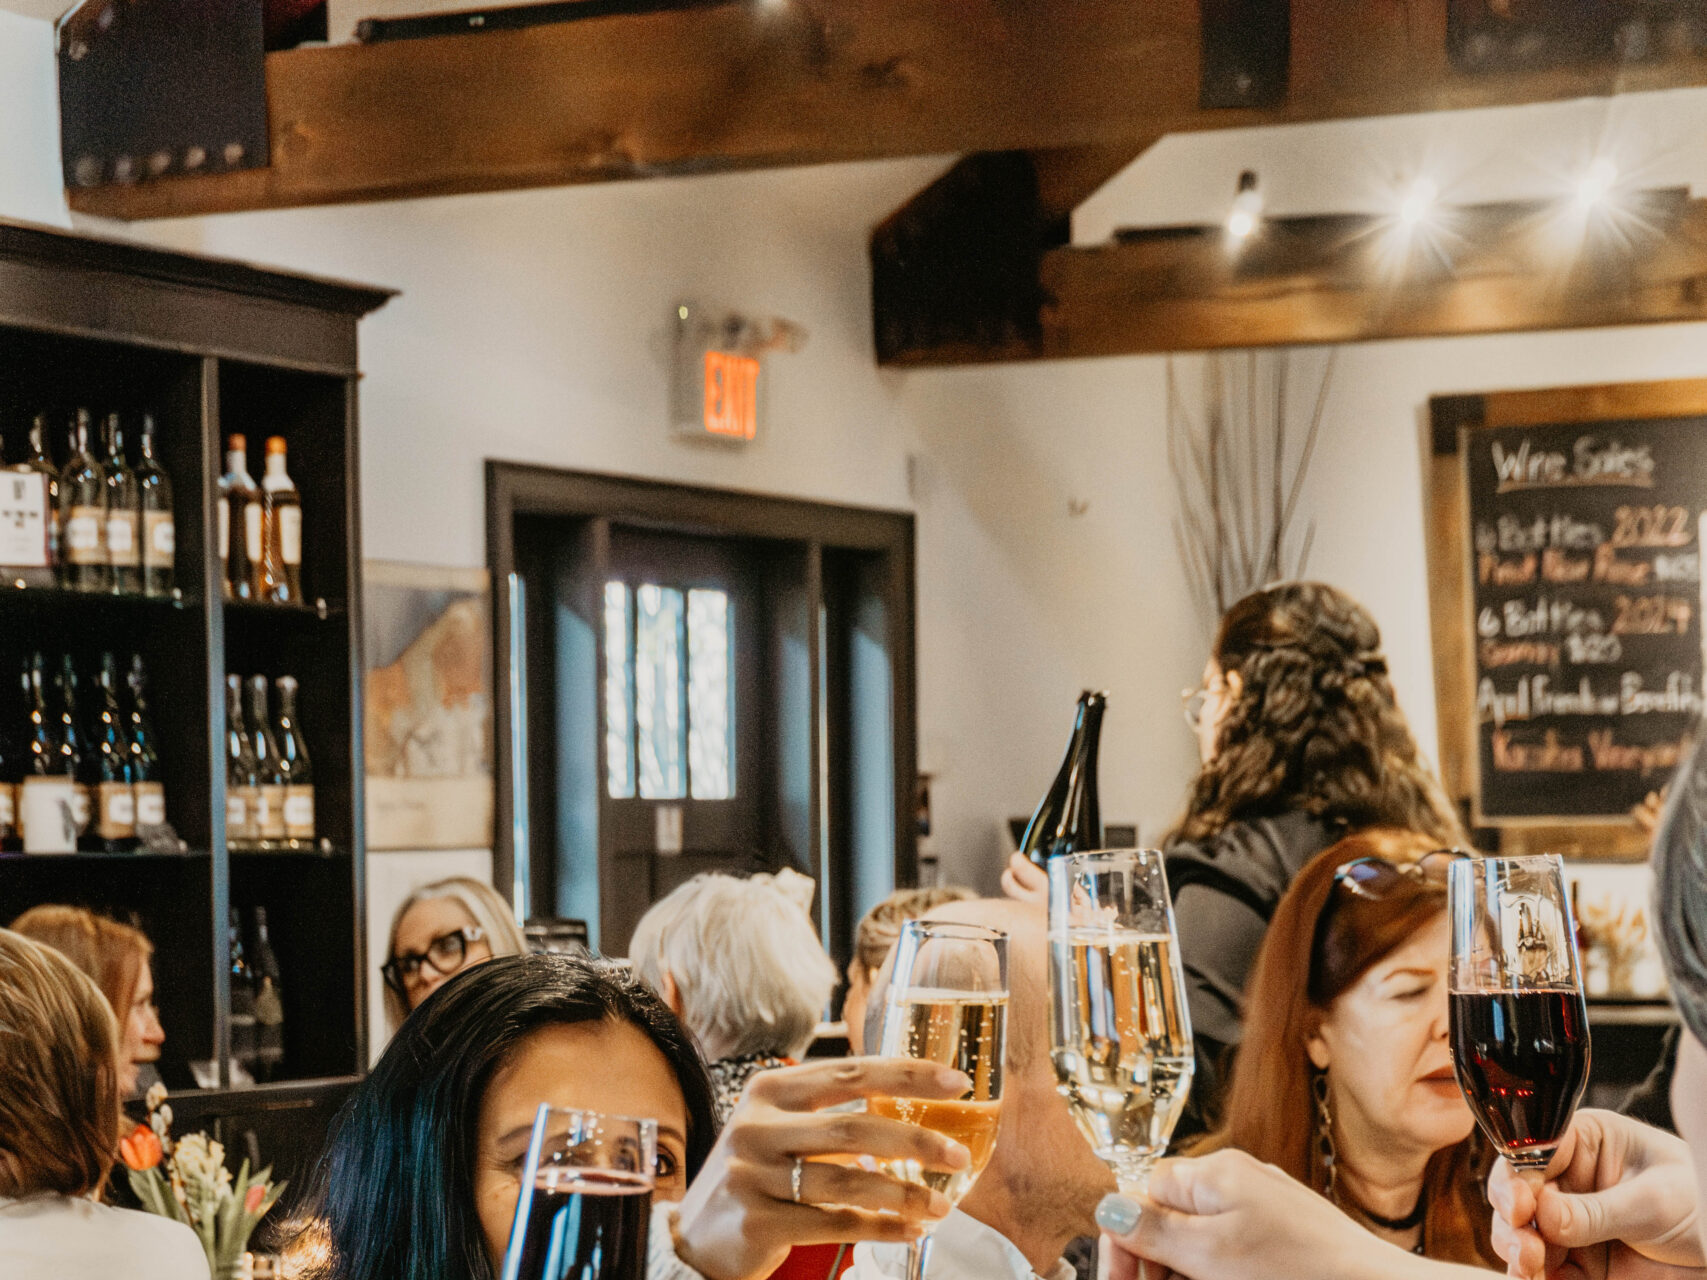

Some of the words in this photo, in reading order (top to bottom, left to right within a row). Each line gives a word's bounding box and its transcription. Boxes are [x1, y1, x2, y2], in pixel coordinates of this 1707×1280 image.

[704, 351, 760, 440] EXIT
[1610, 503, 1695, 548] 2022
[1478, 606, 1500, 638] 6
